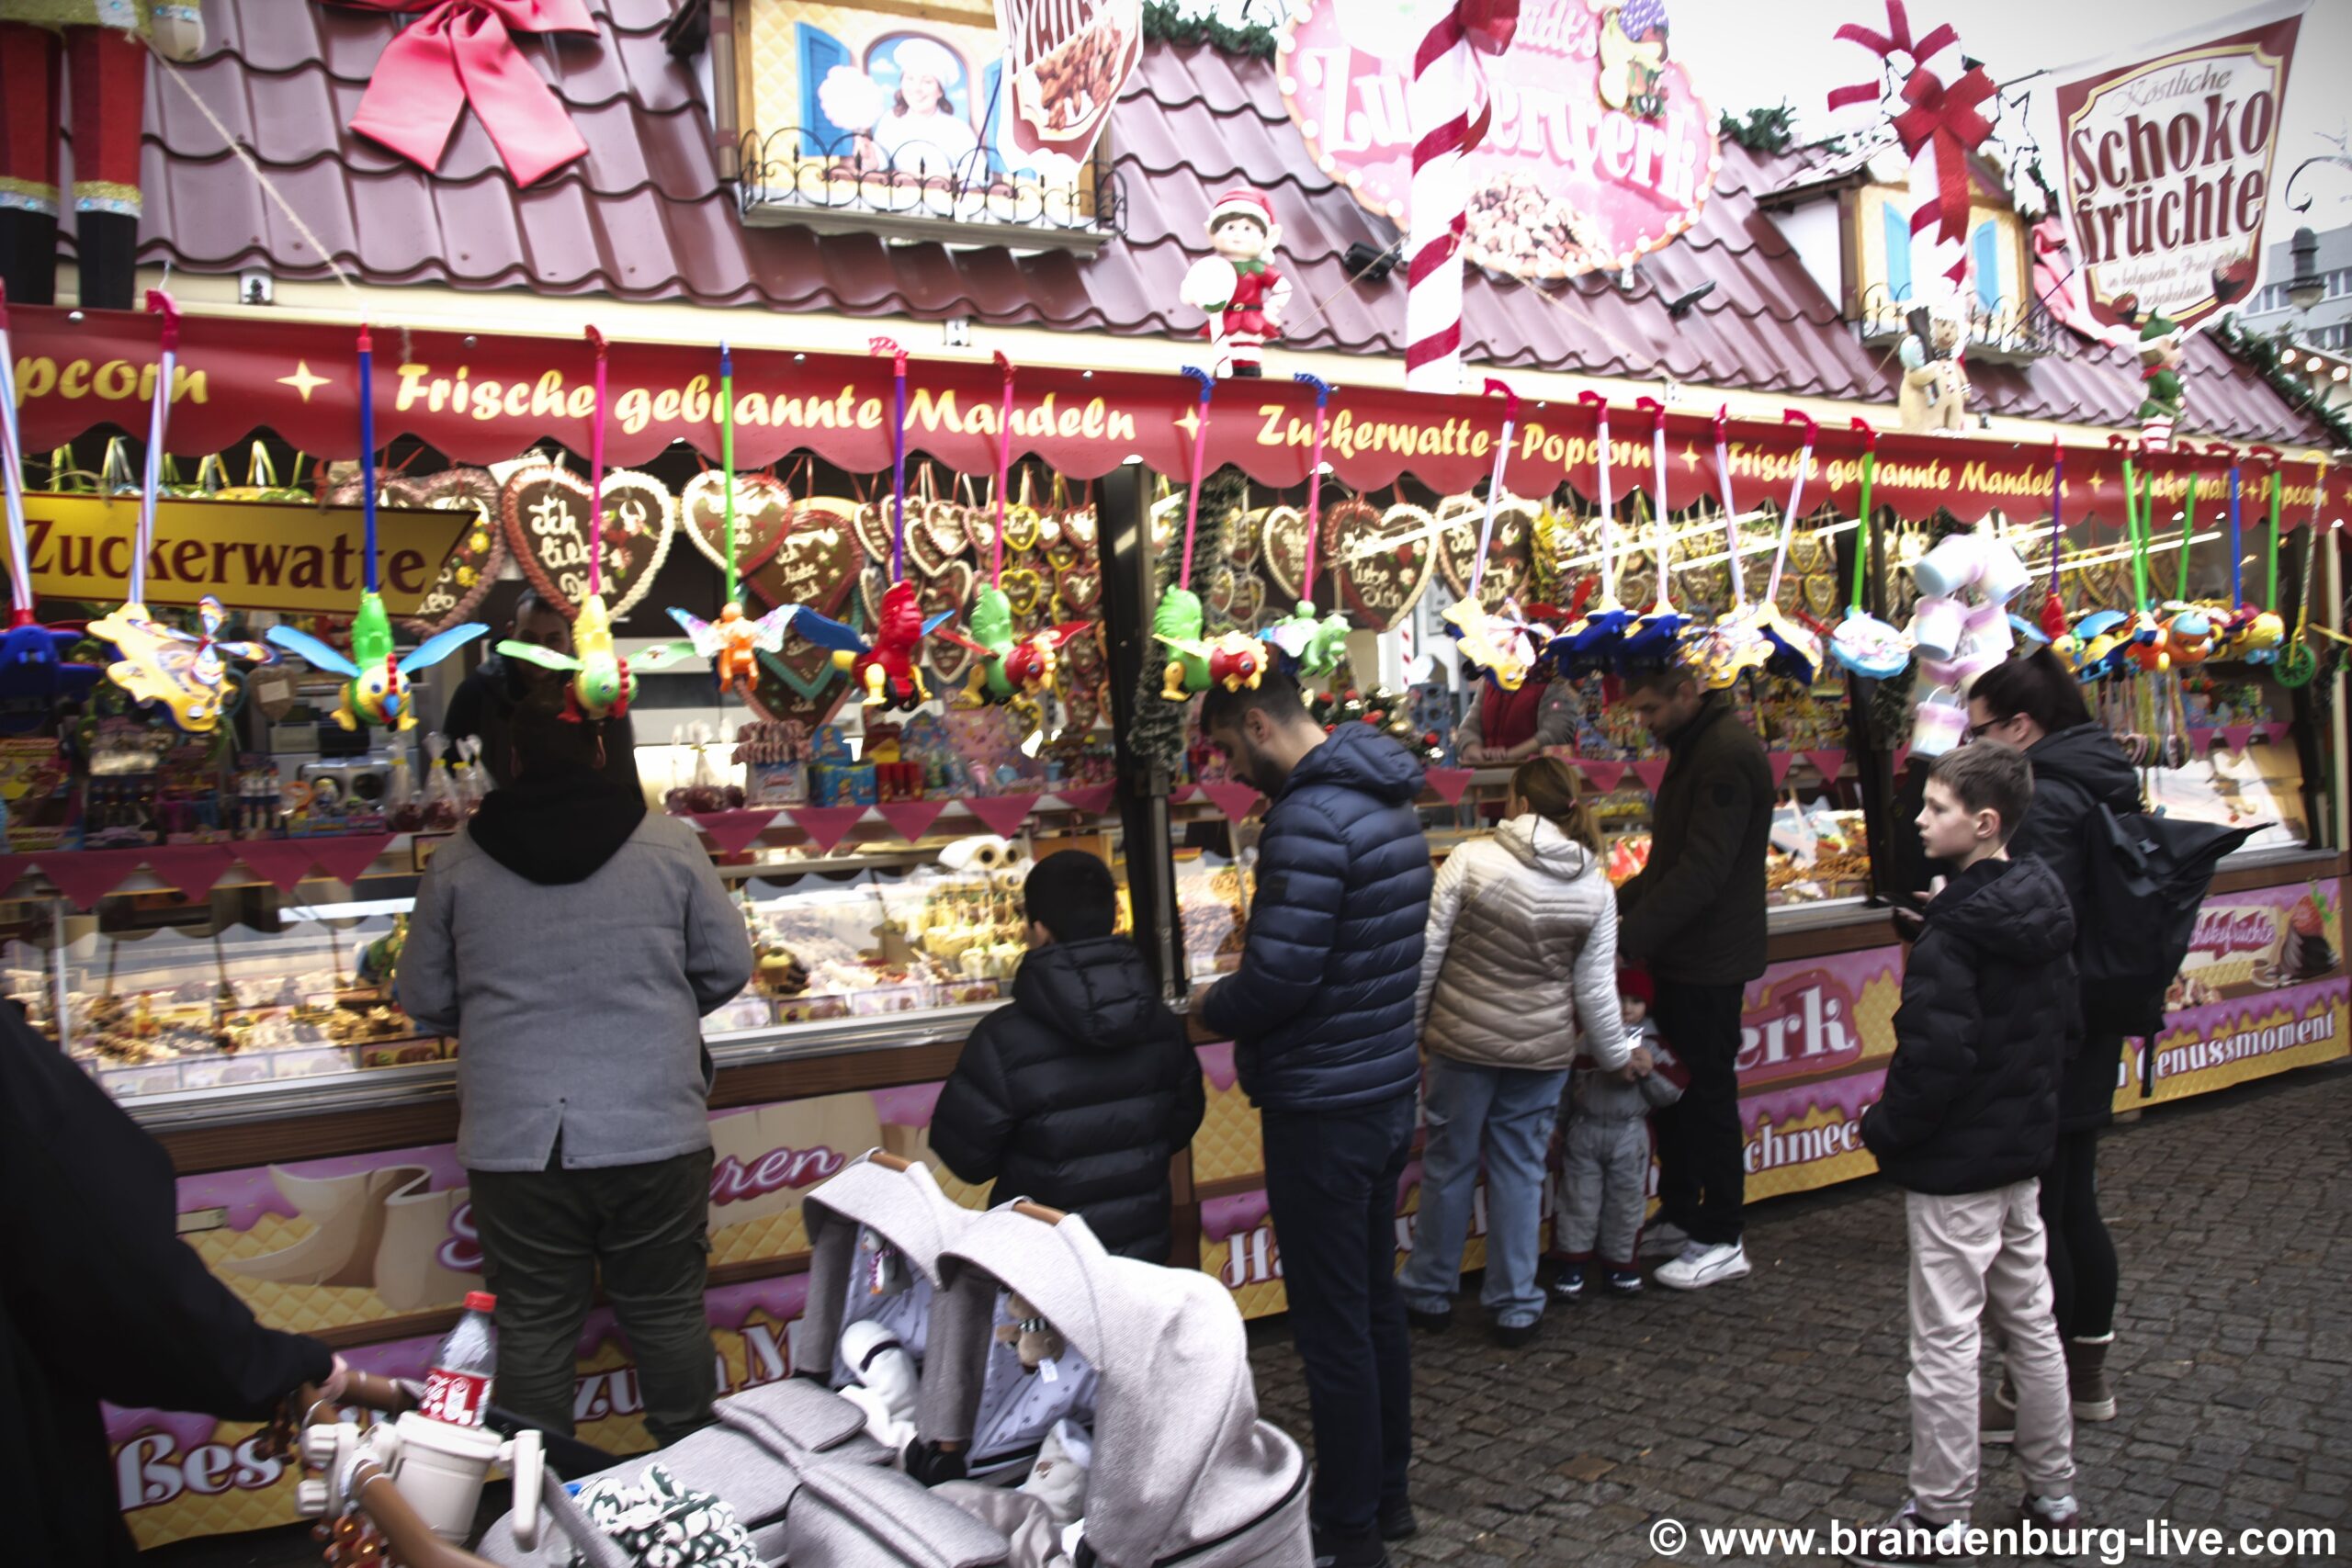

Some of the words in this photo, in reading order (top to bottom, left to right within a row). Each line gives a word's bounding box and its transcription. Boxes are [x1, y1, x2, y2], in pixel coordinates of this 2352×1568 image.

[1300, 44, 1696, 209] Zuerwerk
[2110, 62, 2233, 117] Köstliche
[2071, 89, 2274, 196] Schoko
[2075, 165, 2265, 265] früchte
[395, 363, 596, 421] Frische
[901, 388, 1136, 441] Mandeln
[1256, 404, 1489, 459] Zuckerwatte
